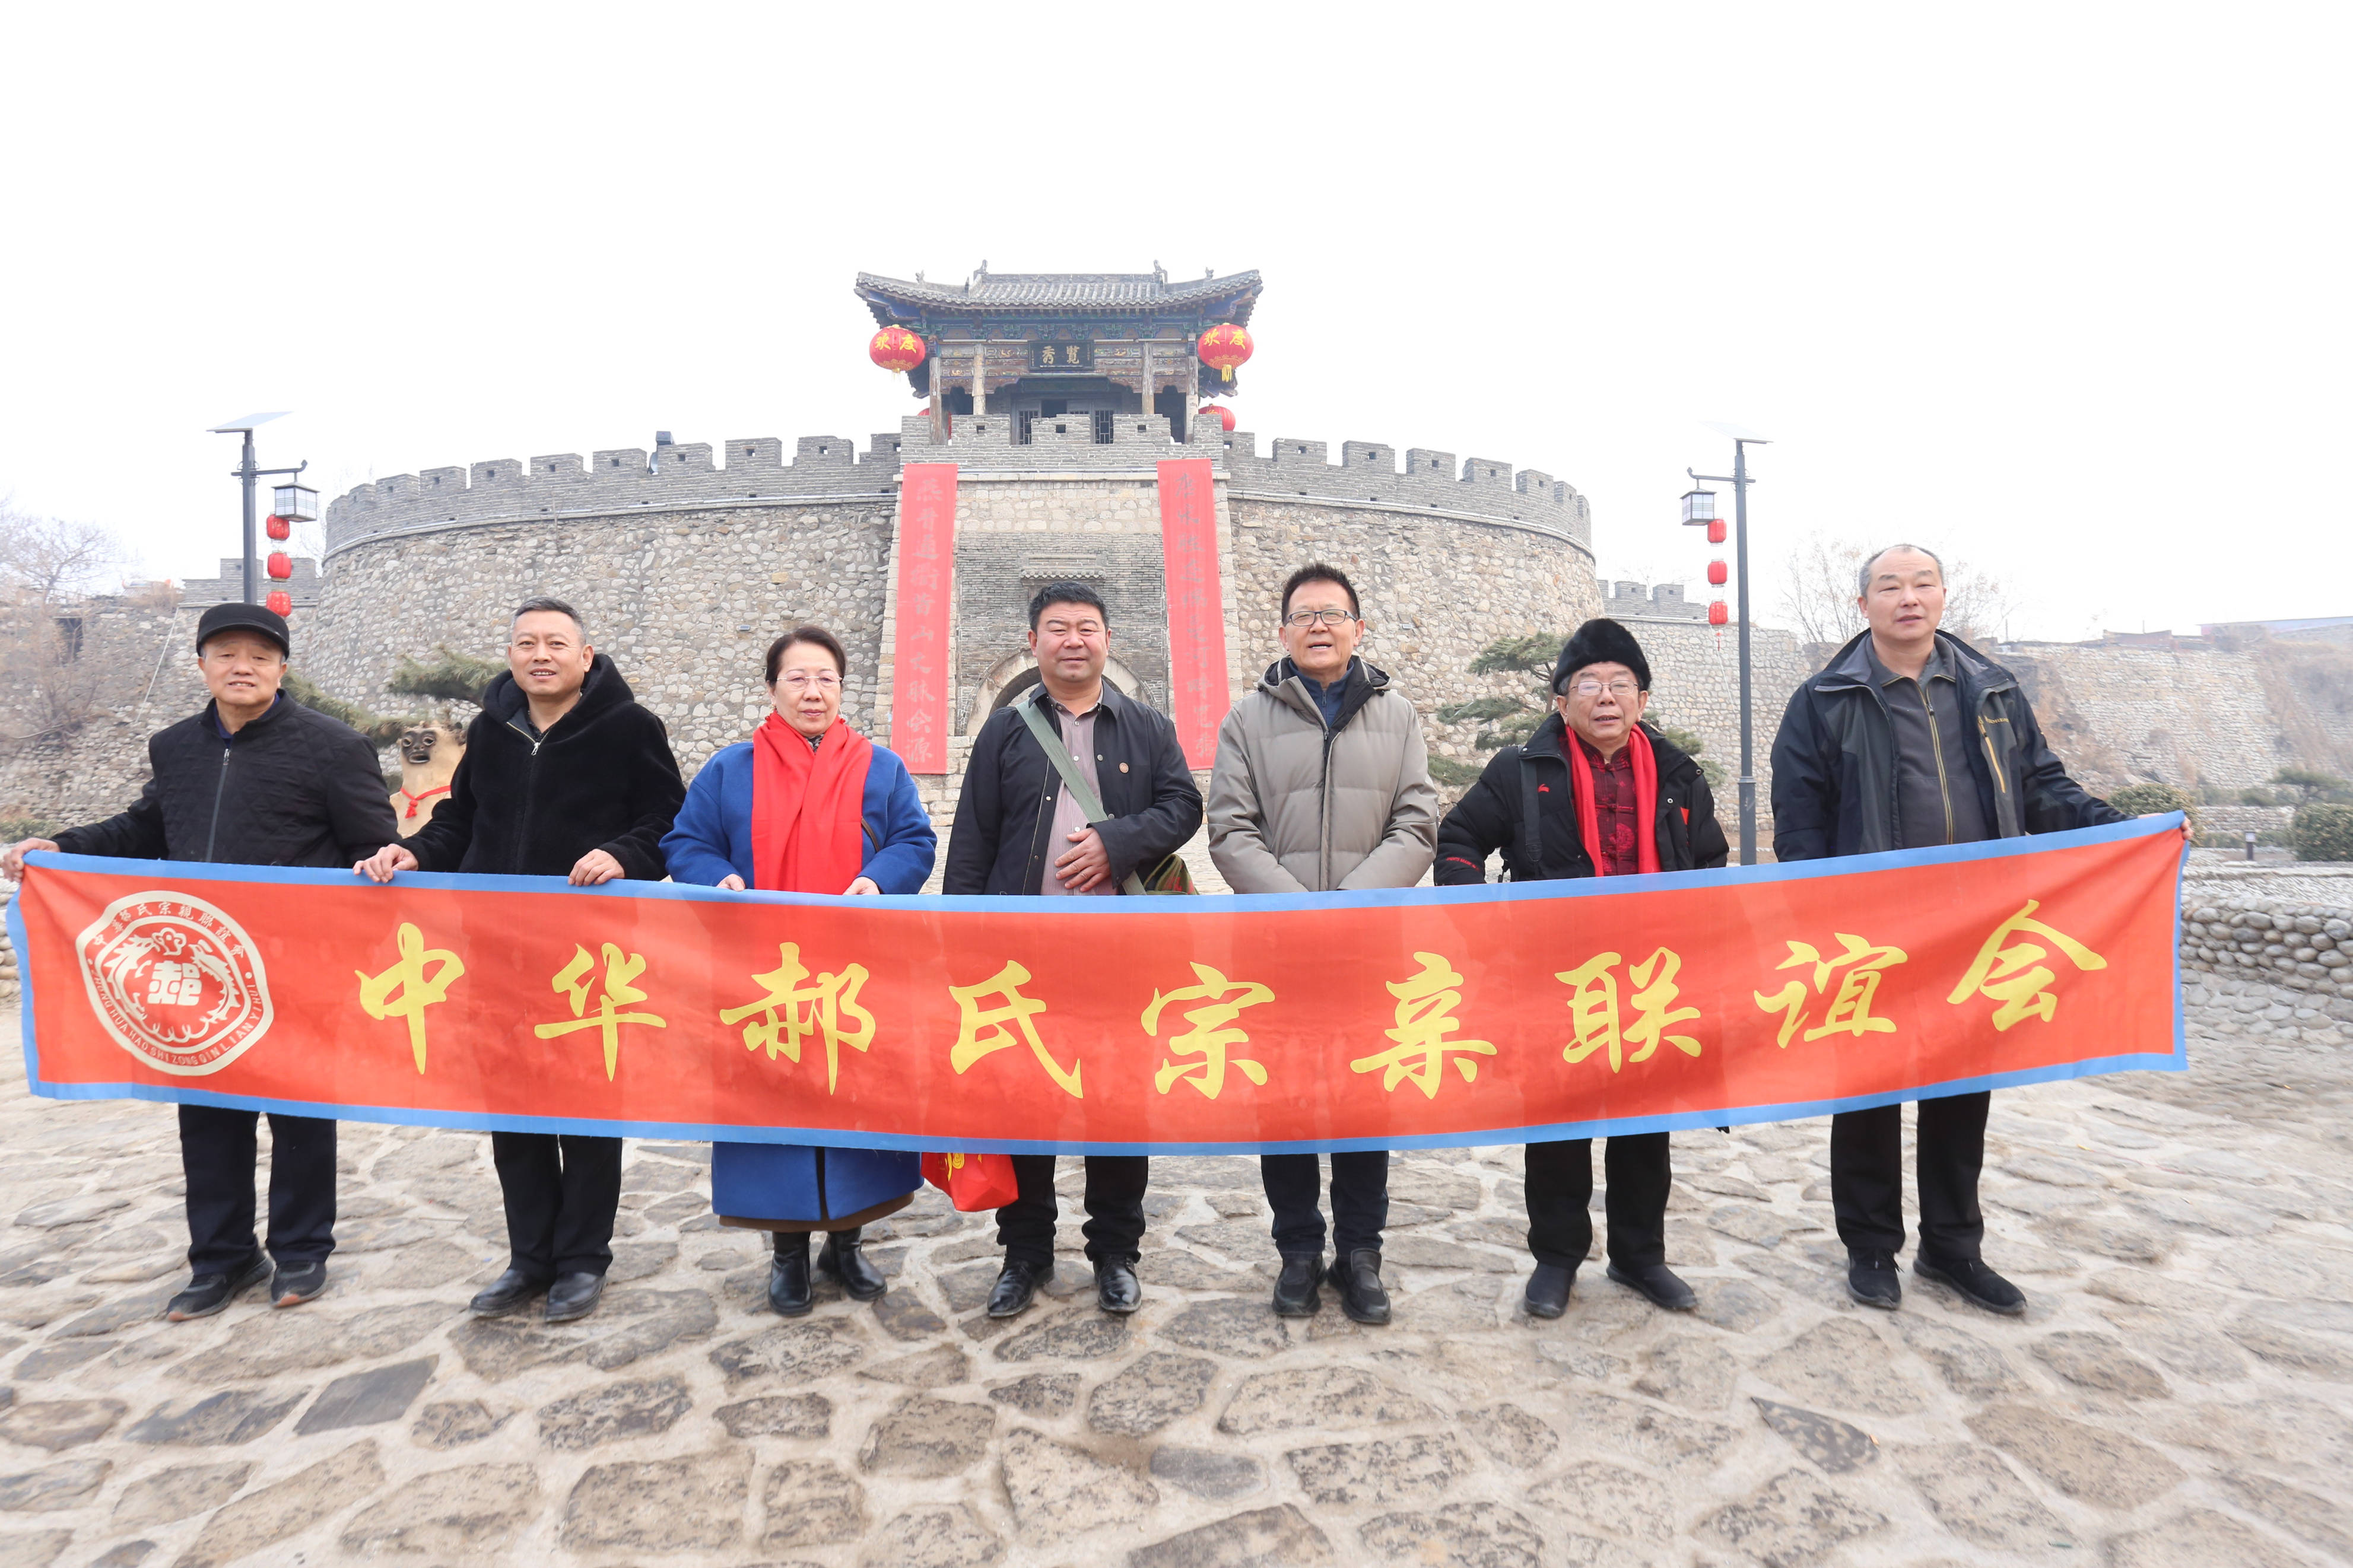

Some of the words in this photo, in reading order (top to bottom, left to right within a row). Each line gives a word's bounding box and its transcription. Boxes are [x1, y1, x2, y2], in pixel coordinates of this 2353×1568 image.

[875, 333, 916, 354] 欢度
[1204, 329, 1246, 350] 欢度
[355, 900, 2107, 1099] 中华郝氏宗亲联谊会
[109, 1009, 129, 1033] HUA
[128, 1030, 148, 1051] HAO
[150, 1047, 169, 1062] SHI
[220, 1022, 254, 1052] LIAN
